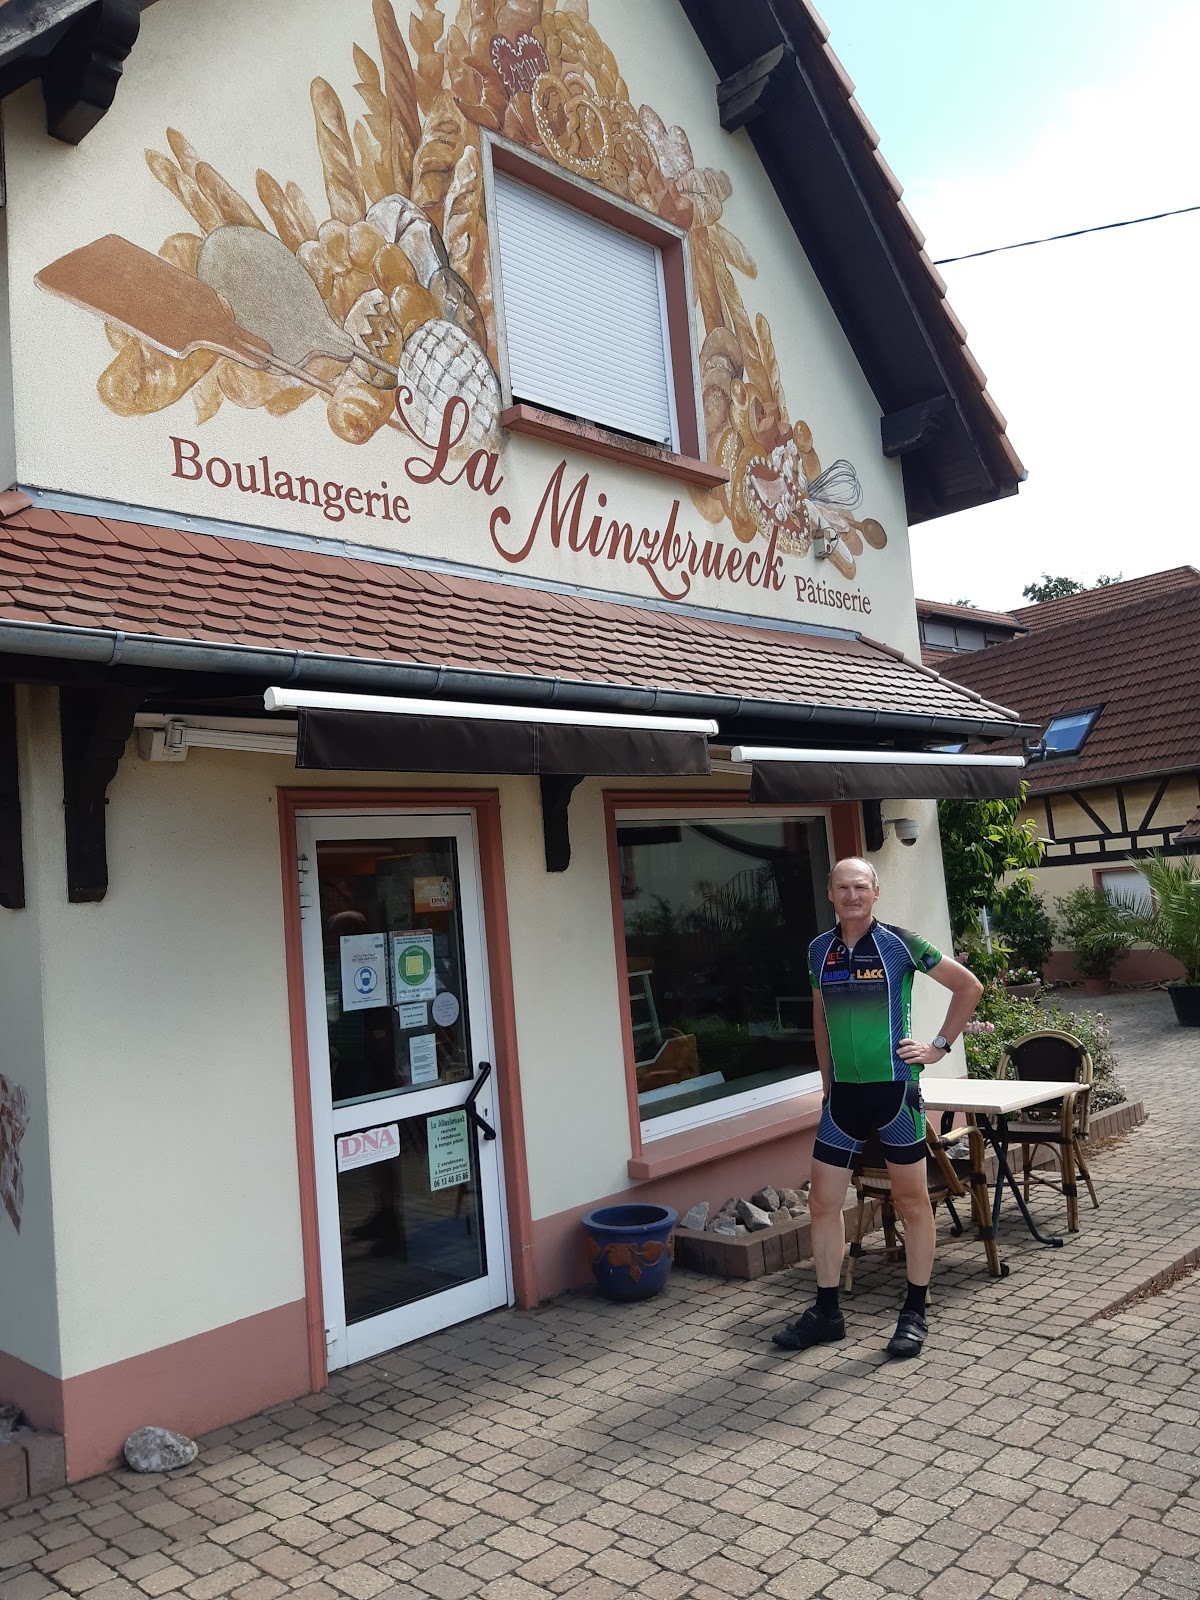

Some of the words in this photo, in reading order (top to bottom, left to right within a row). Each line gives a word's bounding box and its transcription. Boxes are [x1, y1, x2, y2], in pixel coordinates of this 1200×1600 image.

[395, 385, 503, 496] La
[169, 436, 411, 524] Boulangerie
[490, 459, 786, 600] Minzbrueck
[795, 574, 872, 615] Pâtisserie
[431, 896, 446, 904] DNA
[341, 1129, 396, 1157] DNA
[438, 1167, 452, 1176] temps
[441, 1178, 447, 1186] 13
